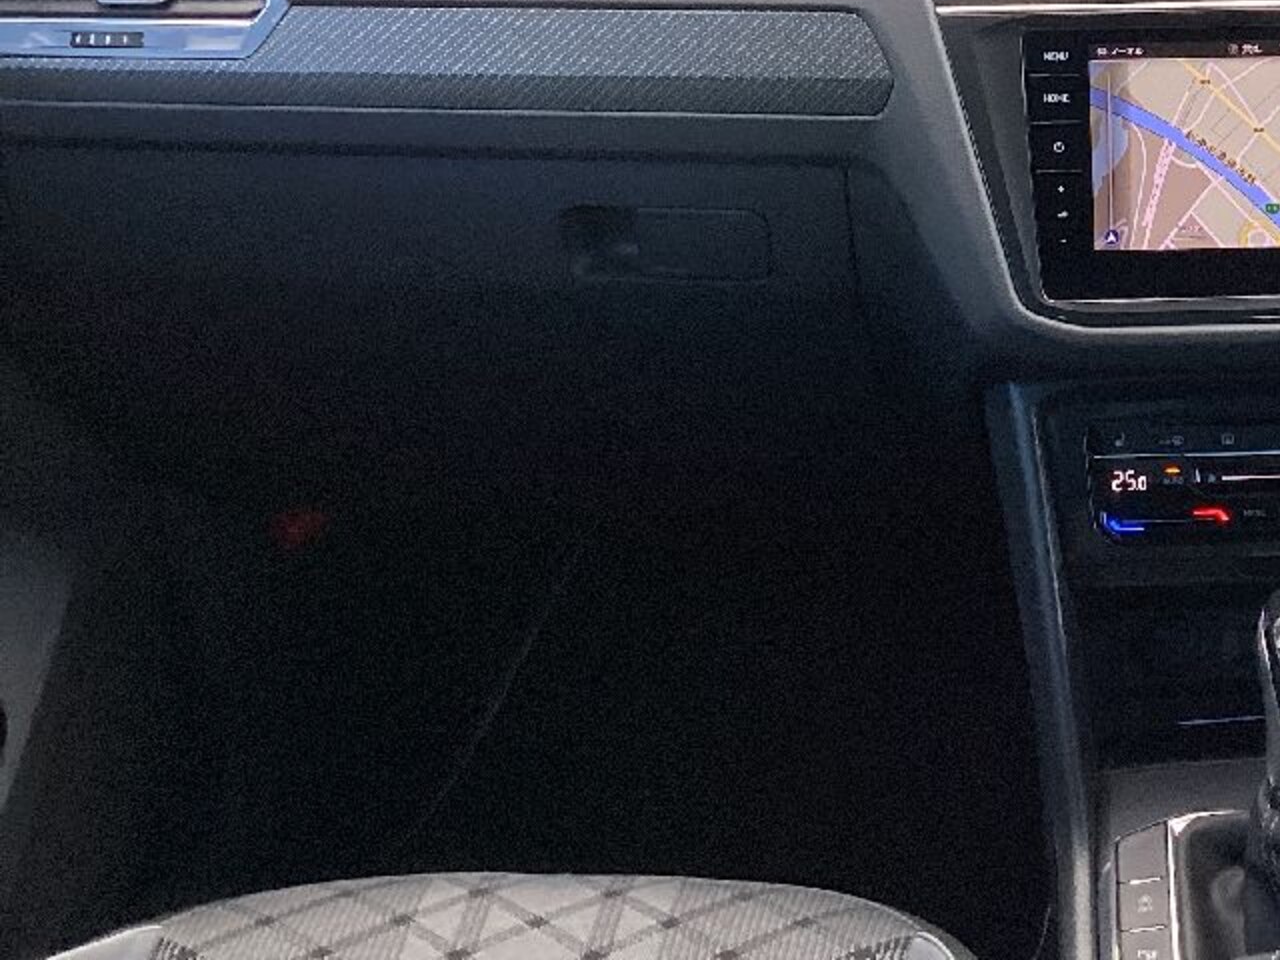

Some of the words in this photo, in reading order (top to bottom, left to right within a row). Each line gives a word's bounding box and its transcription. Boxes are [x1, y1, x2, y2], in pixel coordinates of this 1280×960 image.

[1043, 51, 1069, 62] MENU
[1043, 93, 1070, 103] HOME
[1111, 469, 1146, 492] 25.0
